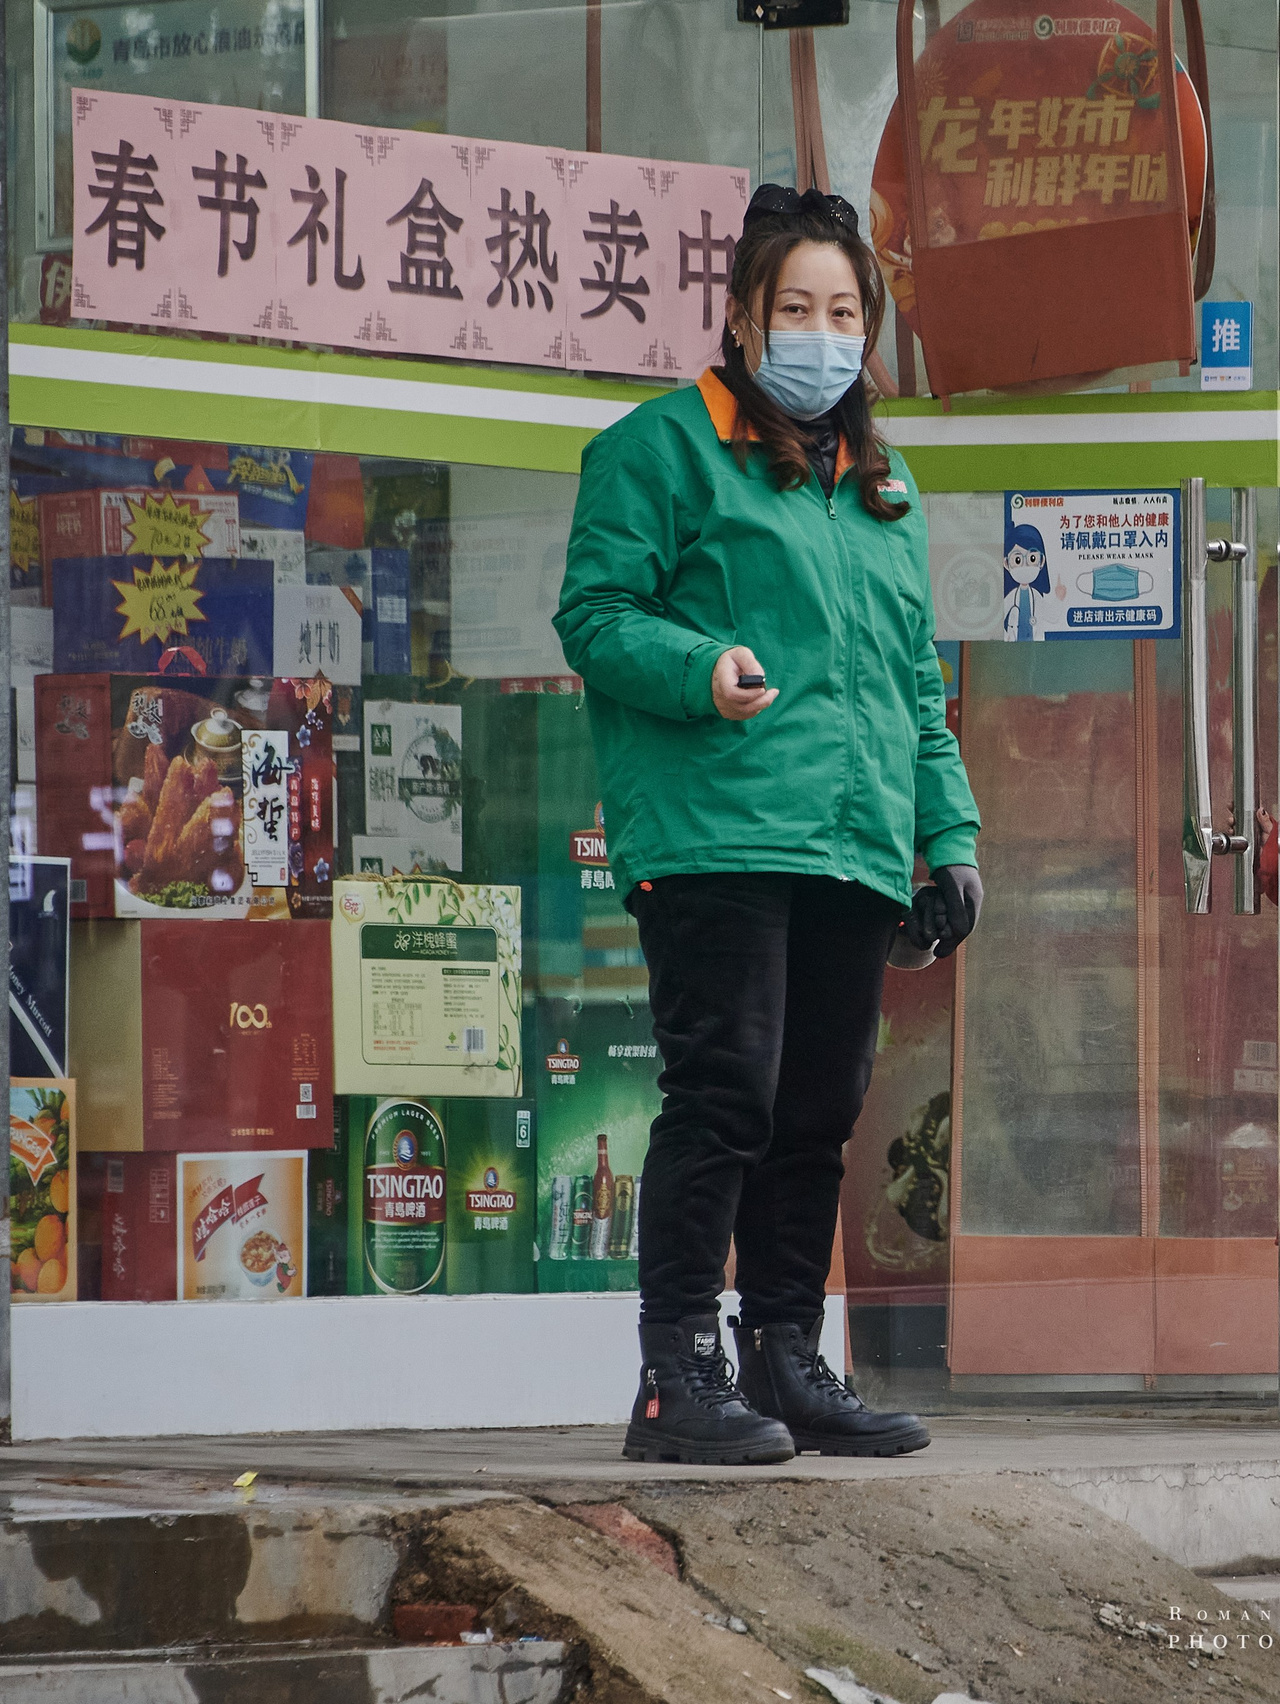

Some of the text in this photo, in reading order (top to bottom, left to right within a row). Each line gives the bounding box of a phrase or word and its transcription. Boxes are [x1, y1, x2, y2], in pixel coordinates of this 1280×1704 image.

[85, 139, 736, 330] 春节礼盒热卖中
[1213, 319, 1240, 352] 推
[1059, 512, 1170, 529] 为了您和他人的健康
[1060, 529, 1169, 550] 请佩戴口罩入内
[1073, 609, 1157, 623] 进店请出示健康码
[574, 837, 607, 857] TSIN
[412, 931, 458, 950] 洋槐蜂蜜
[26, 994, 53, 1038] Murcott
[548, 1058, 579, 1069] TSINGTAO
[401, 1110, 425, 1121] LAGER
[519, 1126, 527, 1139] 6
[367, 1174, 443, 1199] TSINGTAO
[469, 1194, 513, 1208] TSINGTAO
